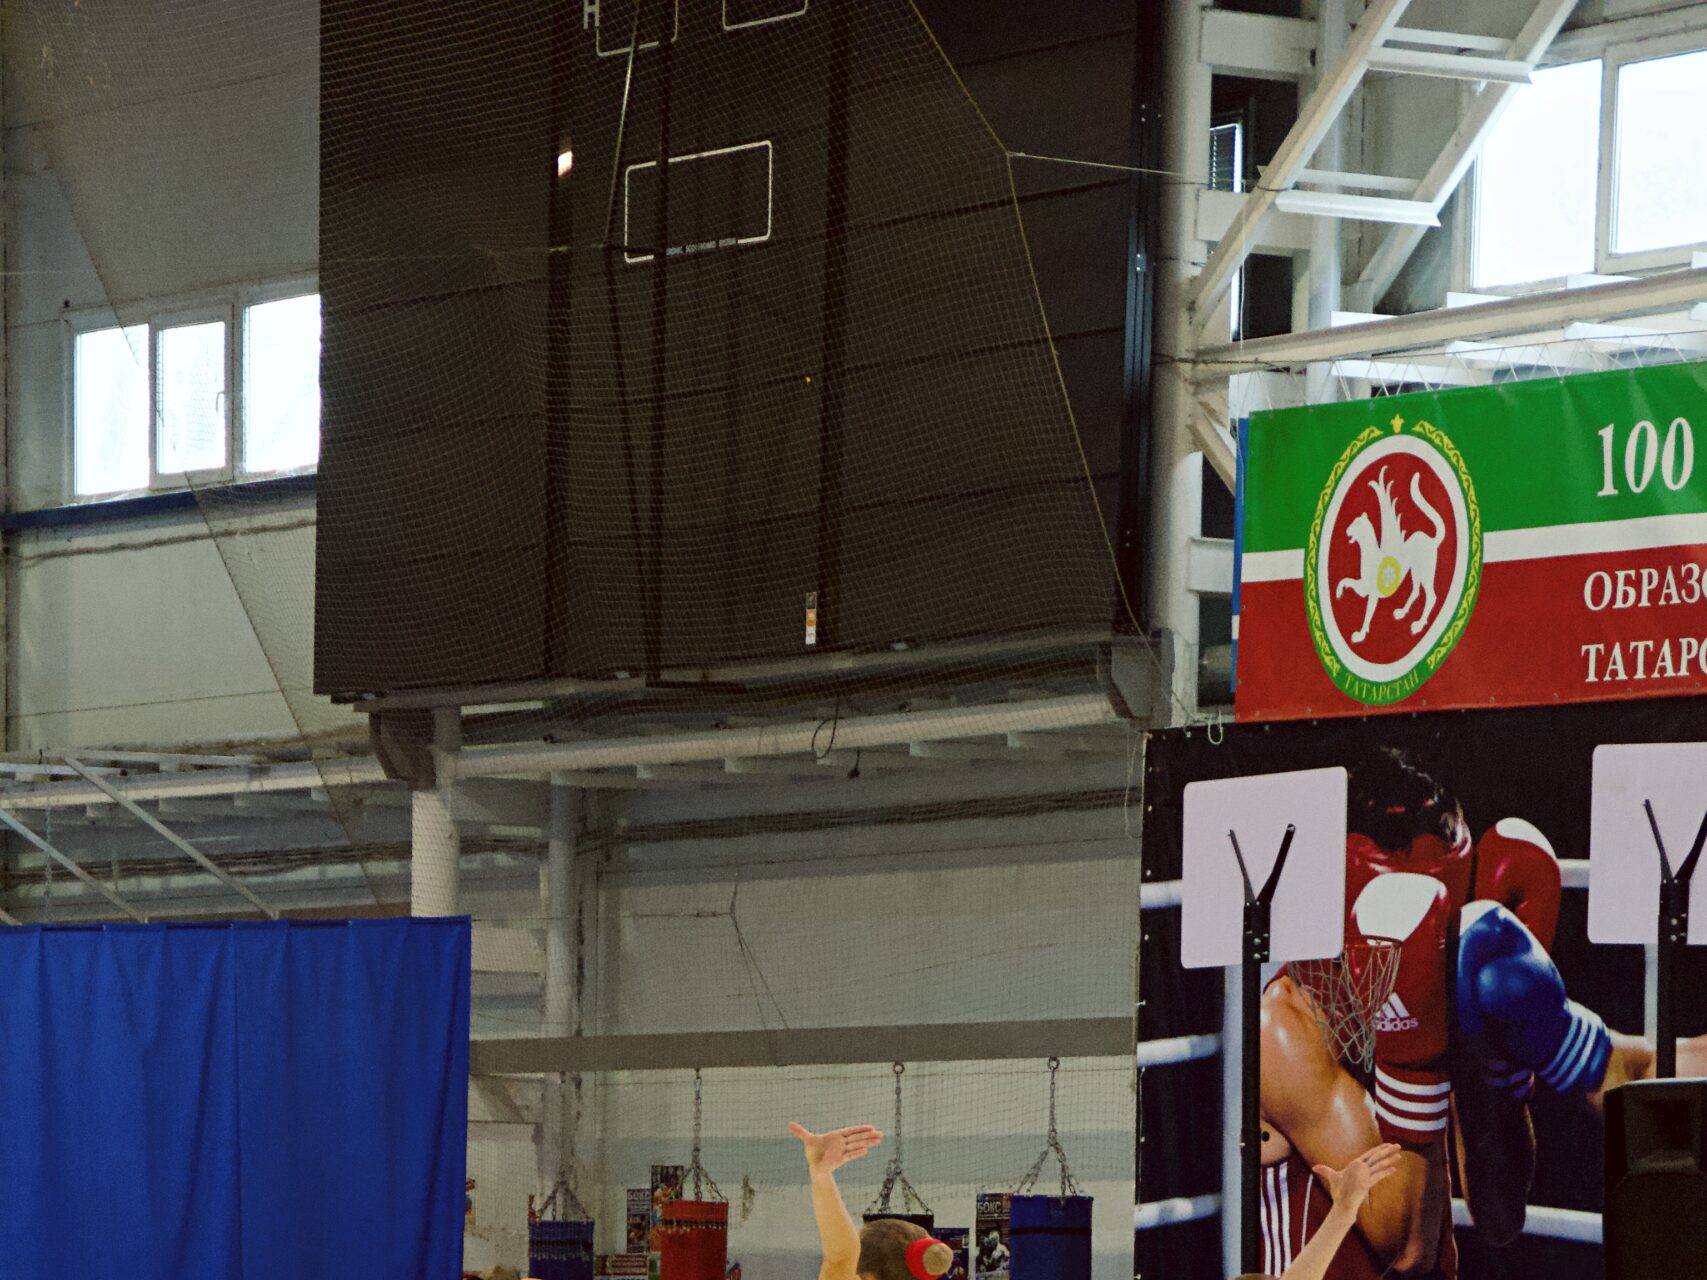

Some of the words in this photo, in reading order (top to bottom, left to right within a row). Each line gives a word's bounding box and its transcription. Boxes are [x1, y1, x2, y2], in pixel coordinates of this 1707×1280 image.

[1597, 416, 1695, 497] 100
[1583, 562, 1707, 612] ОБРАЗ
[1344, 669, 1419, 701] ТАТАРСТАН
[977, 1201, 1001, 1213] БОКС
